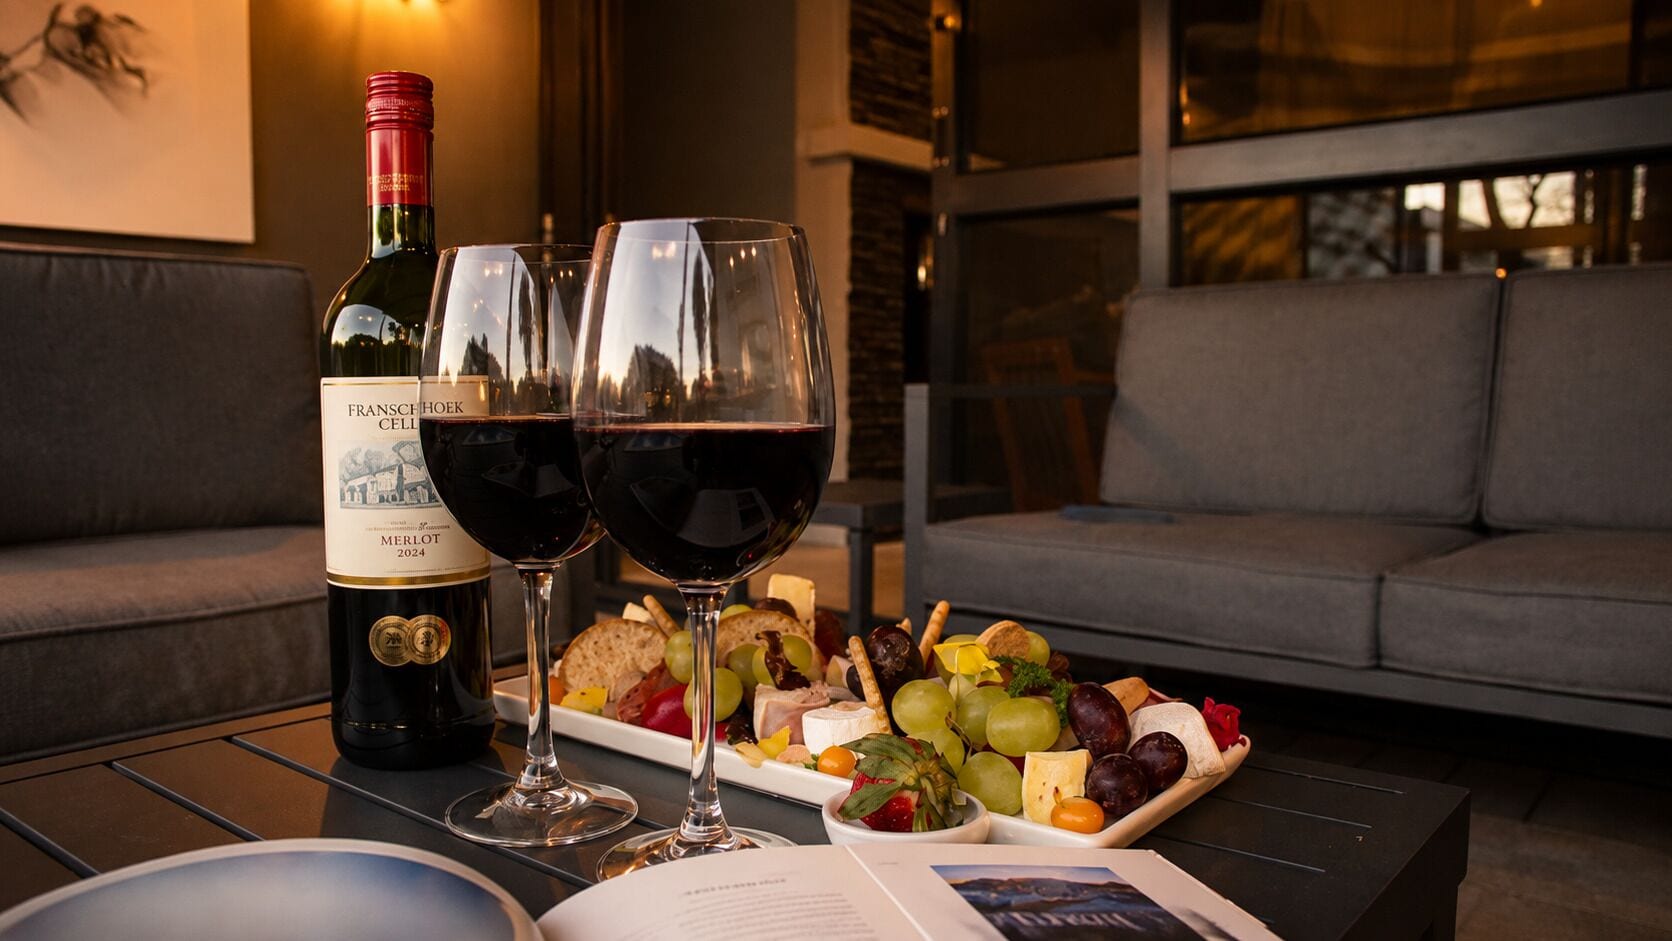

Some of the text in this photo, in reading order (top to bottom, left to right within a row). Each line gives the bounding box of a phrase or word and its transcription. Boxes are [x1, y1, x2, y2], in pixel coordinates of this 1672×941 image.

[378, 418, 418, 431] CELL
[380, 533, 441, 546] MERLOT
[397, 548, 425, 558] 2024
